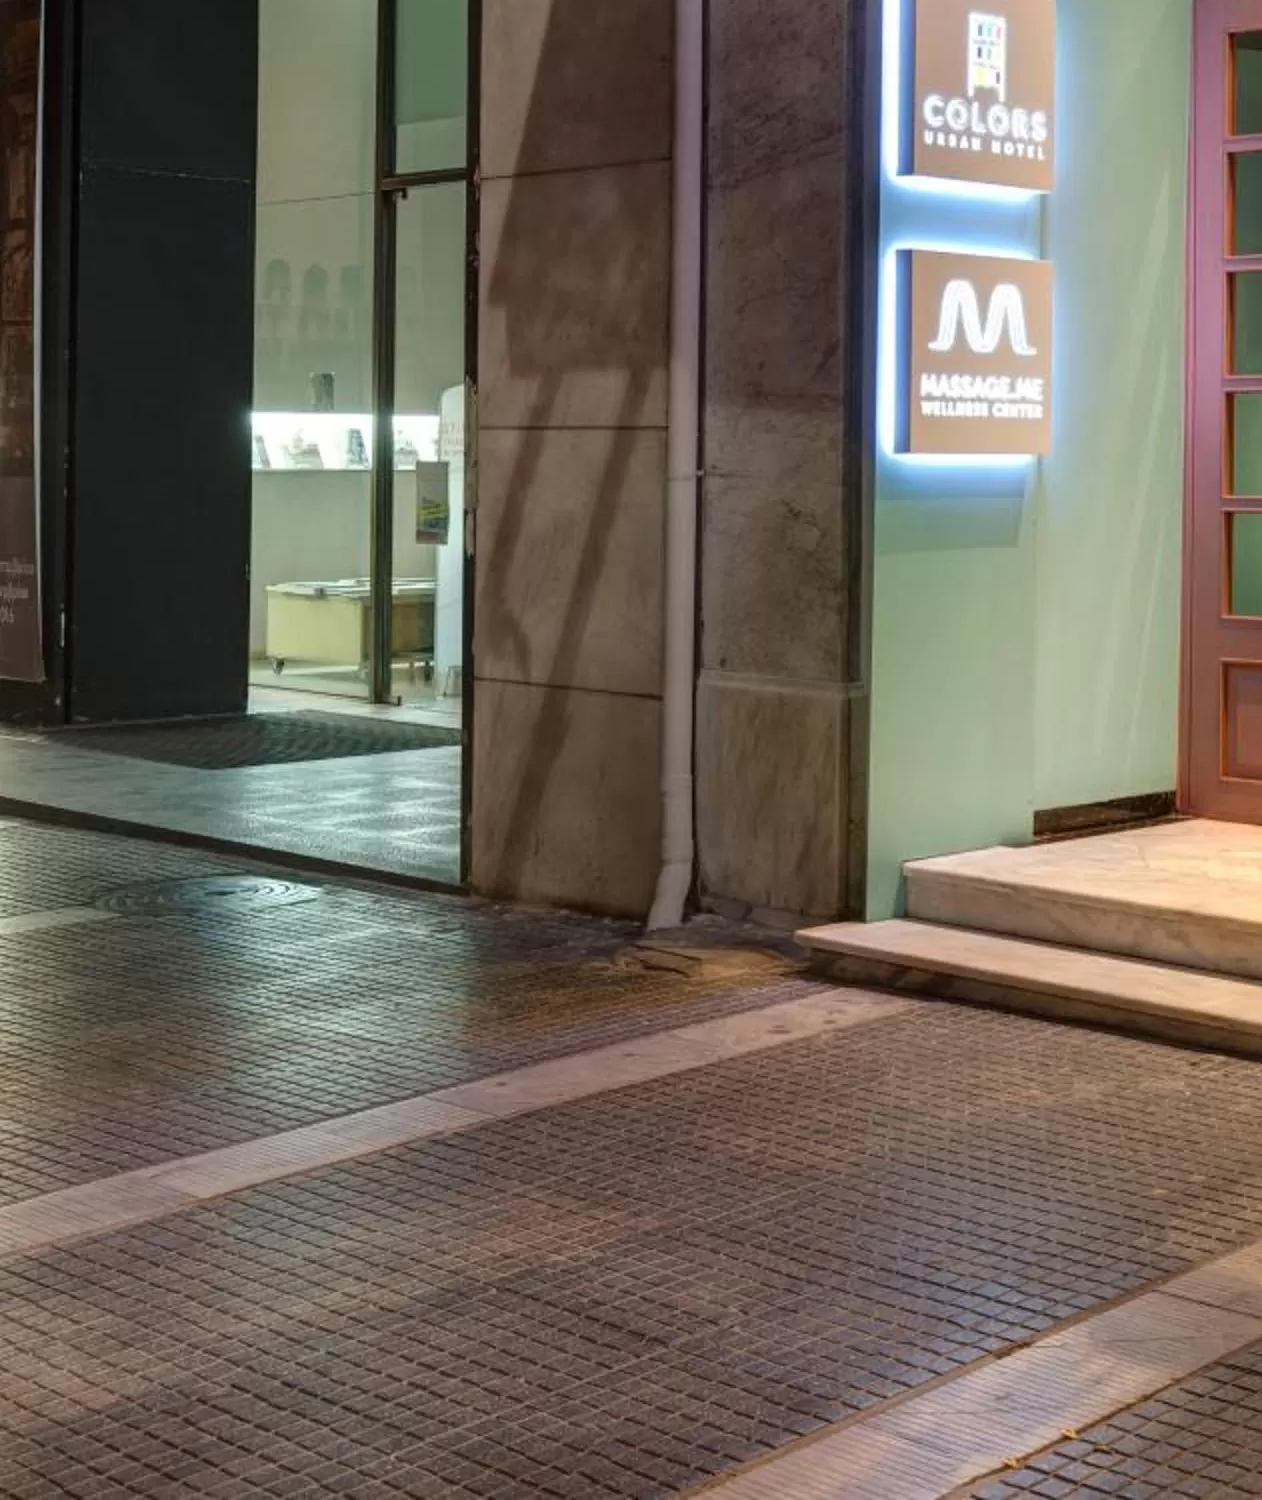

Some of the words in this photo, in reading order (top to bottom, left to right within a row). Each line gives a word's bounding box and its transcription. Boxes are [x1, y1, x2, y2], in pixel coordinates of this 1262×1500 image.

[923, 93, 1048, 142] COLORS
[923, 129, 982, 152] URBAN
[991, 139, 1046, 162] HOTEL
[920, 400, 990, 418] WELLNESS
[990, 402, 1044, 420] CENTER
